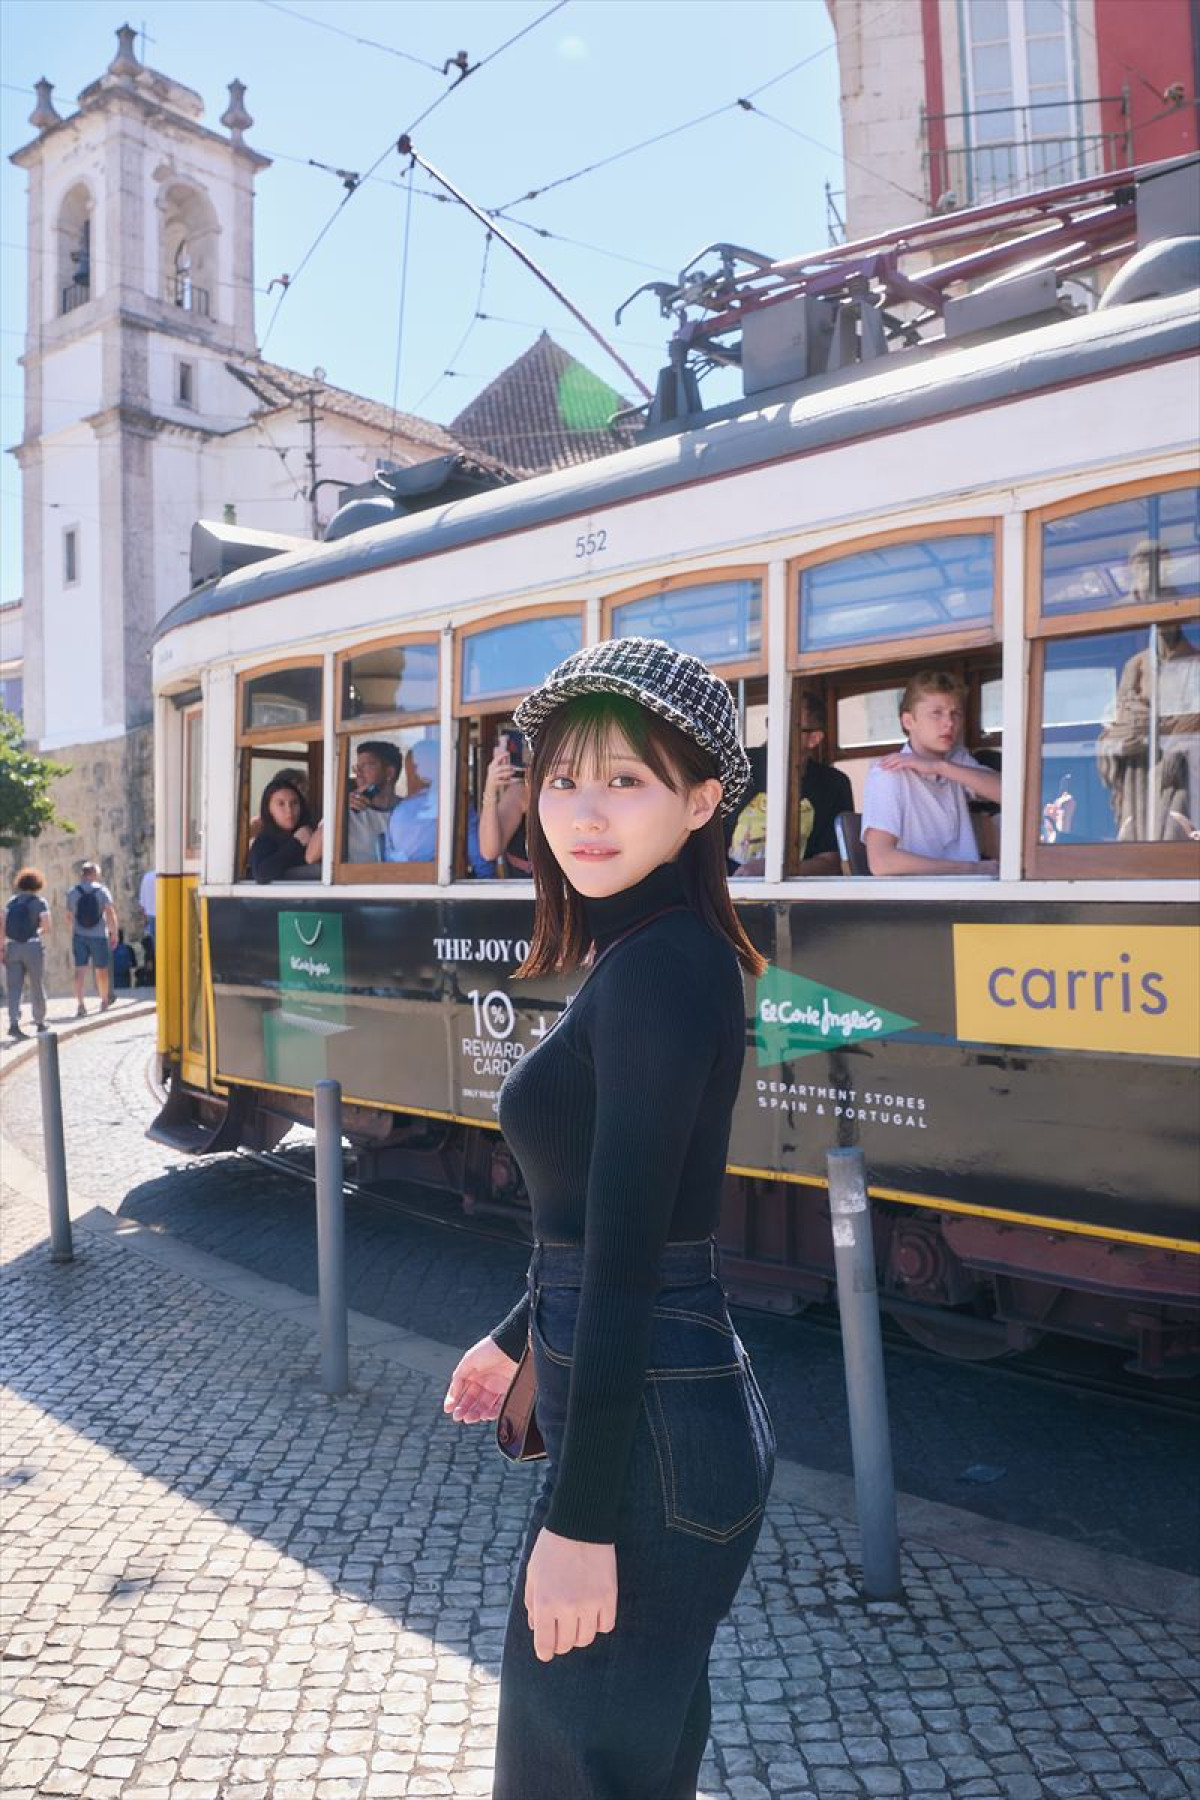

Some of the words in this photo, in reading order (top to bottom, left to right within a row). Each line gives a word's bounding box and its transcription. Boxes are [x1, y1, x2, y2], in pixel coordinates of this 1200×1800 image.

[575, 529, 607, 559] 552
[433, 938, 473, 961] THE
[474, 938, 513, 962] JOY
[988, 952, 1168, 1015] carris
[760, 999, 778, 1022] El
[778, 1001, 820, 1026] Corte
[821, 998, 882, 1037] Inglés
[461, 1038, 525, 1059] REWARD
[473, 1058, 512, 1075] CARD
[756, 1079, 857, 1102] DEPARTMENT
[864, 1092, 925, 1111] STORES
[758, 1096, 808, 1113] SPAIN
[816, 1103, 825, 1115] &
[834, 1106, 928, 1129] PORTUGAL
